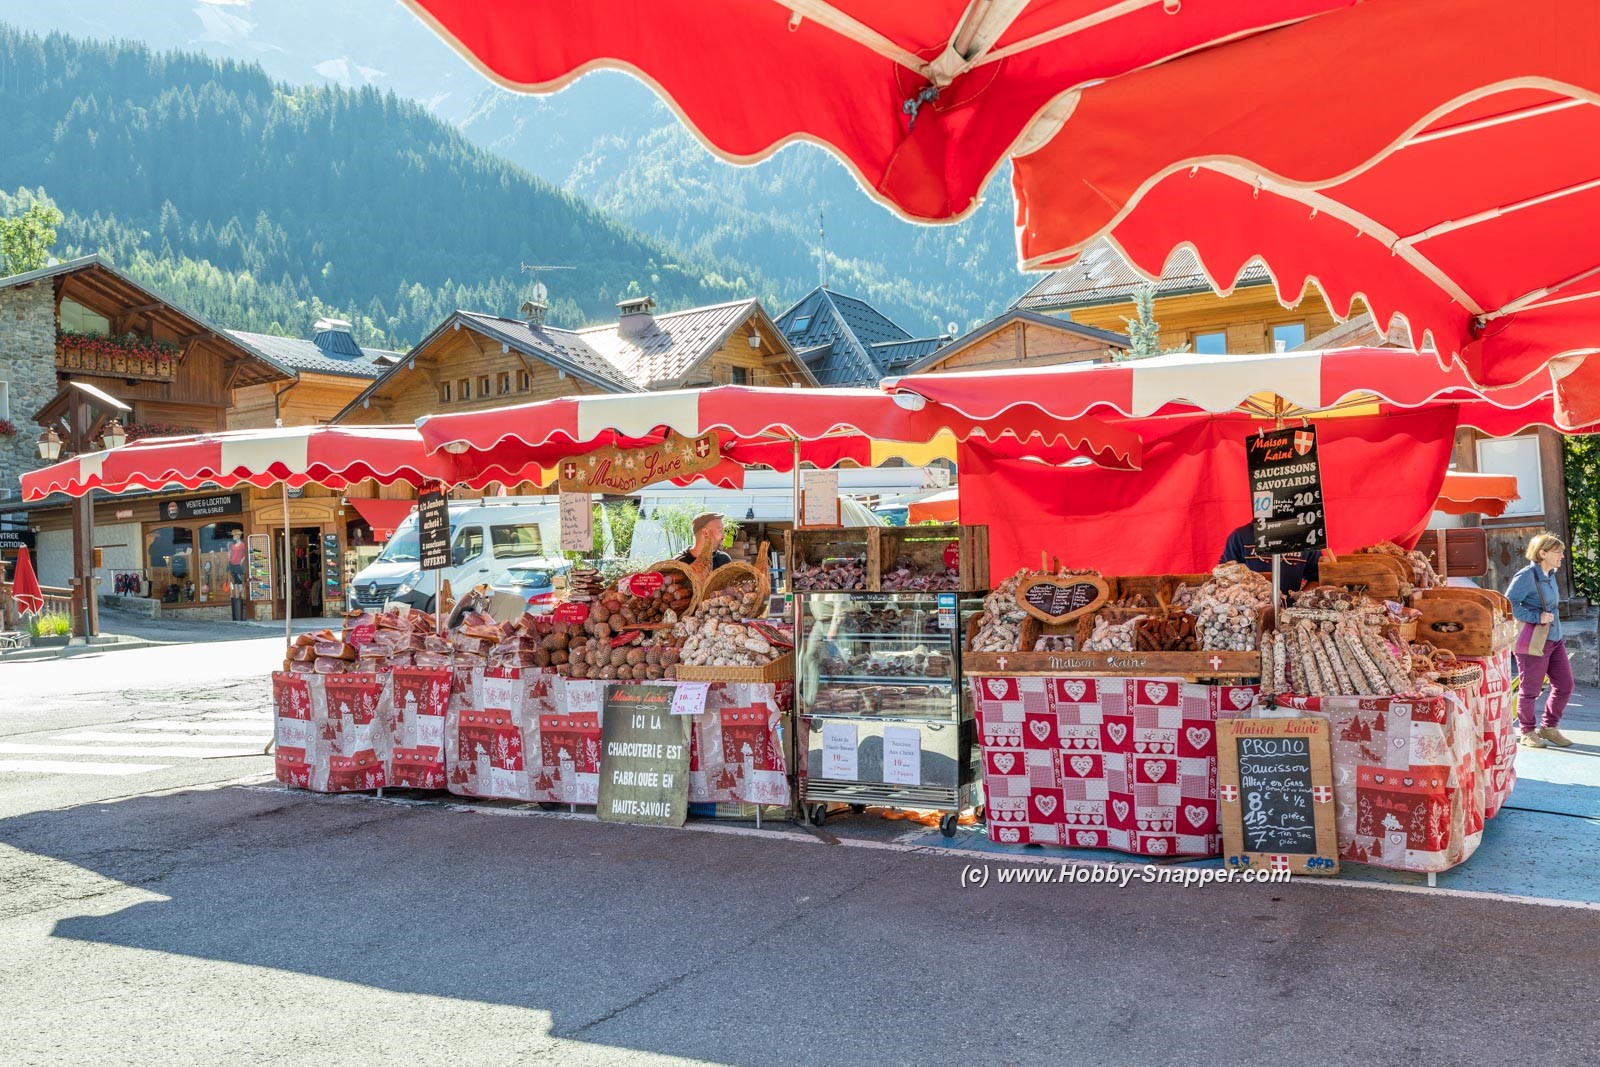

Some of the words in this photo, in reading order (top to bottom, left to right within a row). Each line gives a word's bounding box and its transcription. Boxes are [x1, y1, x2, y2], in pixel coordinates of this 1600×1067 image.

[1251, 437, 1288, 453] Maison
[1264, 447, 1294, 462] Lainé
[588, 459, 637, 491] Maison
[641, 450, 681, 484] Lainé
[1254, 462, 1316, 479] SAUCISSONS
[1256, 474, 1316, 491] SAVOYARDS
[186, 498, 202, 508] VENTE
[206, 496, 231, 506] LOCATION
[1257, 518, 1267, 532] 3
[1258, 535, 1267, 548] 1
[1268, 539, 1282, 547] pour
[424, 555, 446, 567] OFFERTS
[1049, 656, 1096, 668] Maison
[631, 714, 645, 729] ICI
[650, 715, 661, 730] LA
[1231, 721, 1276, 735] Maison
[608, 742, 662, 758] CHARCUTERIE
[666, 745, 682, 760] EST
[1240, 758, 1309, 774] Saucisson
[613, 768, 658, 787] FABRIQUÉE
[662, 774, 673, 788] EN
[612, 799, 670, 817] HAUTE-SAVOIE
[1294, 794, 1306, 808] 1/2
